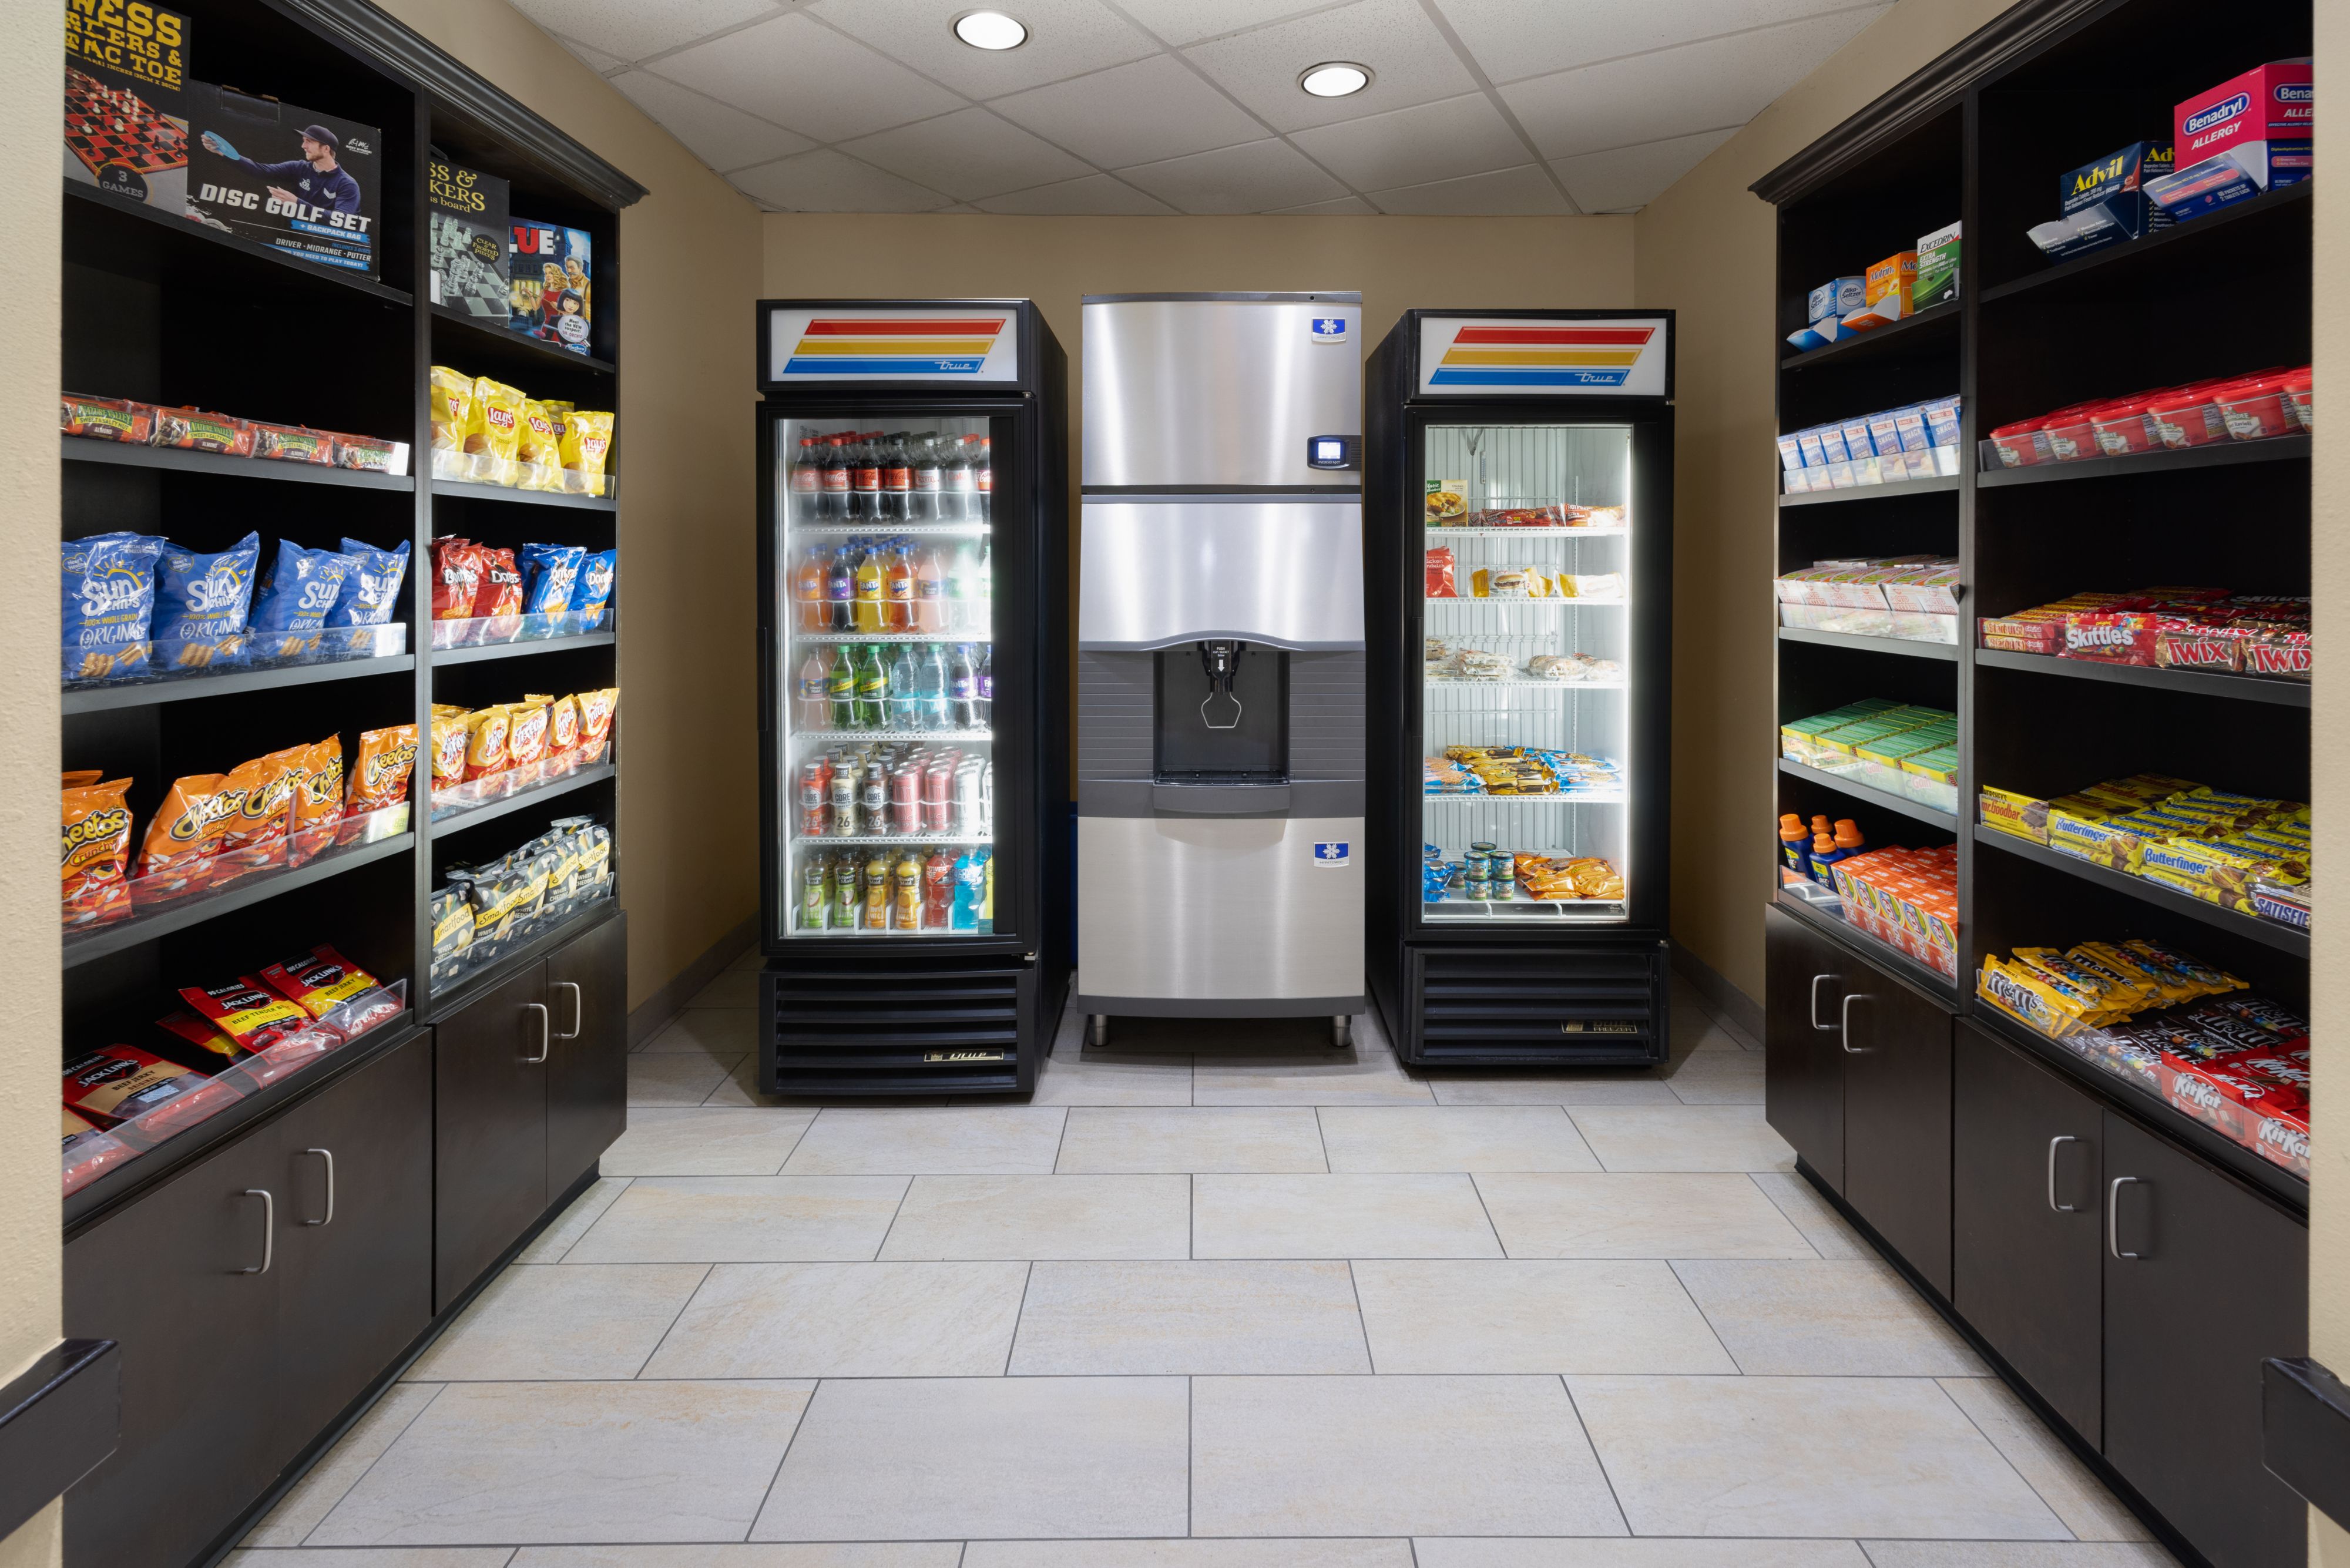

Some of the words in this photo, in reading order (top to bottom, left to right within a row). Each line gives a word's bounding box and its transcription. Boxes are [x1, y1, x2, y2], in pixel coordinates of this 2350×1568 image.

[130, 53, 181, 85] TOE
[2189, 98, 2242, 132] Benadryl
[2191, 121, 2242, 150] ALLERGY
[119, 170, 127, 182] 3
[2071, 155, 2125, 196] Advil
[102, 181, 143, 199] GAMES
[200, 183, 260, 210] DISC
[266, 197, 325, 223] GOLF
[330, 211, 371, 232] SET
[441, 197, 471, 213] board
[307, 223, 346, 238] BACKPACK
[347, 232, 361, 240] BAG
[276, 237, 301, 249] DRIVER
[307, 244, 342, 256] MIDRANGE
[347, 251, 371, 261] PUTTER
[472, 242, 499, 257] FROSTED
[476, 237, 496, 250] CLEAR
[1921, 231, 1955, 253] EXCEDRIN
[1919, 253, 1946, 268] STRENGTH
[1920, 251, 1935, 263] EXTRA
[1870, 266, 1892, 282] Motrin
[934, 360, 975, 370] true
[1574, 372, 1617, 382] true
[1904, 427, 1921, 441] SNACK
[1935, 422, 1956, 435] SNACK
[1851, 438, 1866, 449] SNACK
[1878, 432, 1895, 445] SNACK
[81, 579, 132, 617] Sun
[186, 577, 237, 612] Sun
[1988, 623, 2023, 634] Starburst
[2067, 627, 2134, 649] Skittles
[2165, 637, 2229, 666] Twix
[367, 744, 418, 786] Cheetos
[1866, 760, 1882, 774] Gain
[1911, 774, 1931, 790] Gain
[241, 770, 304, 818] Cheetos
[170, 790, 247, 840] Cheetos
[807, 816, 818, 827] 26
[837, 817, 850, 827] 26
[869, 815, 881, 827] 26
[2056, 817, 2110, 842] Butterfinger
[70, 840, 116, 866] Crunchy
[2145, 847, 2208, 874] Butterfinger
[479, 894, 519, 925] Smartfood
[437, 907, 470, 941] Smartfood
[478, 928, 494, 936] WHITE
[324, 987, 338, 996] BEEF
[338, 978, 355, 991] JERKY
[231, 1015, 250, 1025] BEEF
[250, 1006, 277, 1020] TENDER
[72, 1055, 105, 1071] CALORIES
[78, 1071, 106, 1087] JACK
[112, 1080, 132, 1091] BEEF
[133, 1070, 156, 1083] JERKY
[127, 1076, 159, 1090] ORIGINAL
